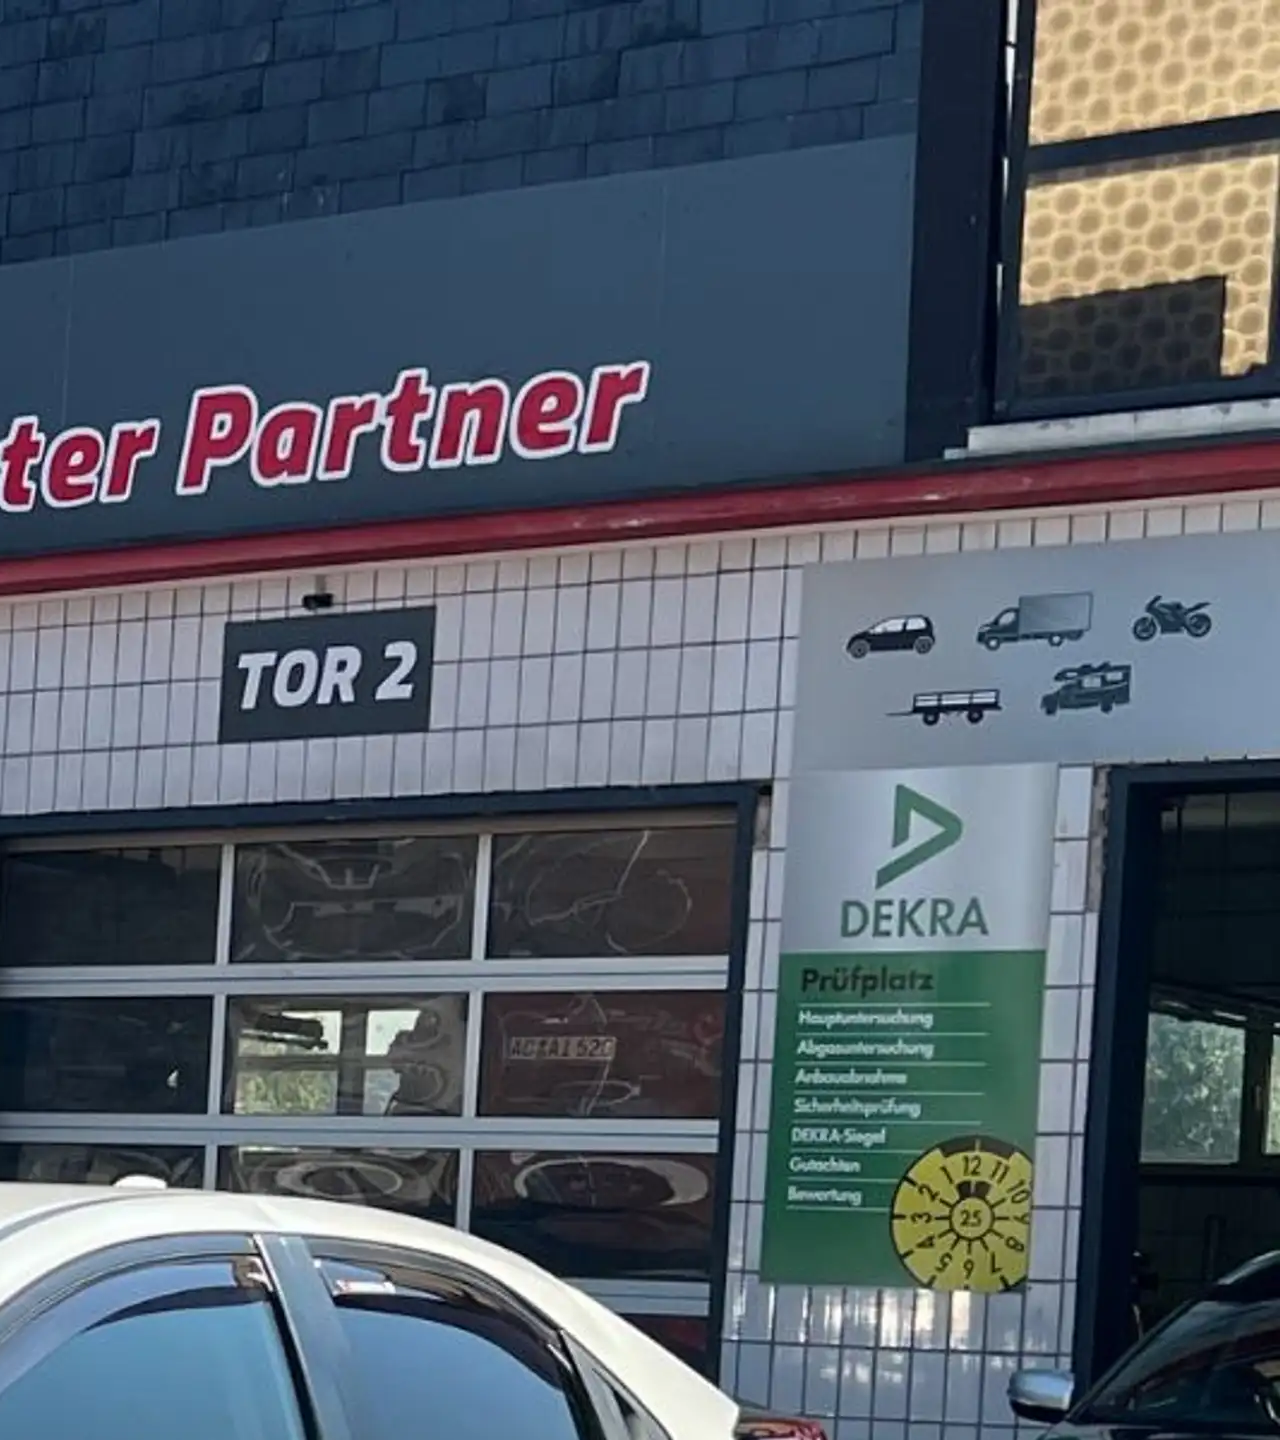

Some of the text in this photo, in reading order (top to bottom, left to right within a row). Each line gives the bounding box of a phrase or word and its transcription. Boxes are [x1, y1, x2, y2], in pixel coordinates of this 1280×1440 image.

[177, 360, 651, 496] Partner
[238, 640, 417, 710] TOR 2
[841, 897, 990, 938] DEKRA
[800, 964, 935, 998] Prüfplatz
[797, 1008, 934, 1030] Hauptuntersuchung
[796, 1038, 935, 1060] Abgasuntersuchung
[794, 1067, 908, 1085] Anbauabnahme
[794, 1097, 922, 1118] Sicherheitsprüfung
[791, 1127, 887, 1147] DEKRA-Siegel
[789, 1156, 861, 1174] Gutachten
[940, 1166, 954, 1184] 1
[963, 1155, 982, 1177] 12
[990, 1161, 1010, 1185] 11
[787, 1185, 863, 1206] Bewertung
[918, 1184, 940, 1201] 2
[1006, 1179, 1031, 1204] 10
[910, 1212, 933, 1224] 3
[960, 1210, 982, 1226] 25
[916, 1235, 936, 1249] 4
[1005, 1236, 1025, 1252] 8
[935, 1252, 953, 1272] 5
[963, 1259, 974, 1279] 6
[991, 1252, 1002, 1274] 7
